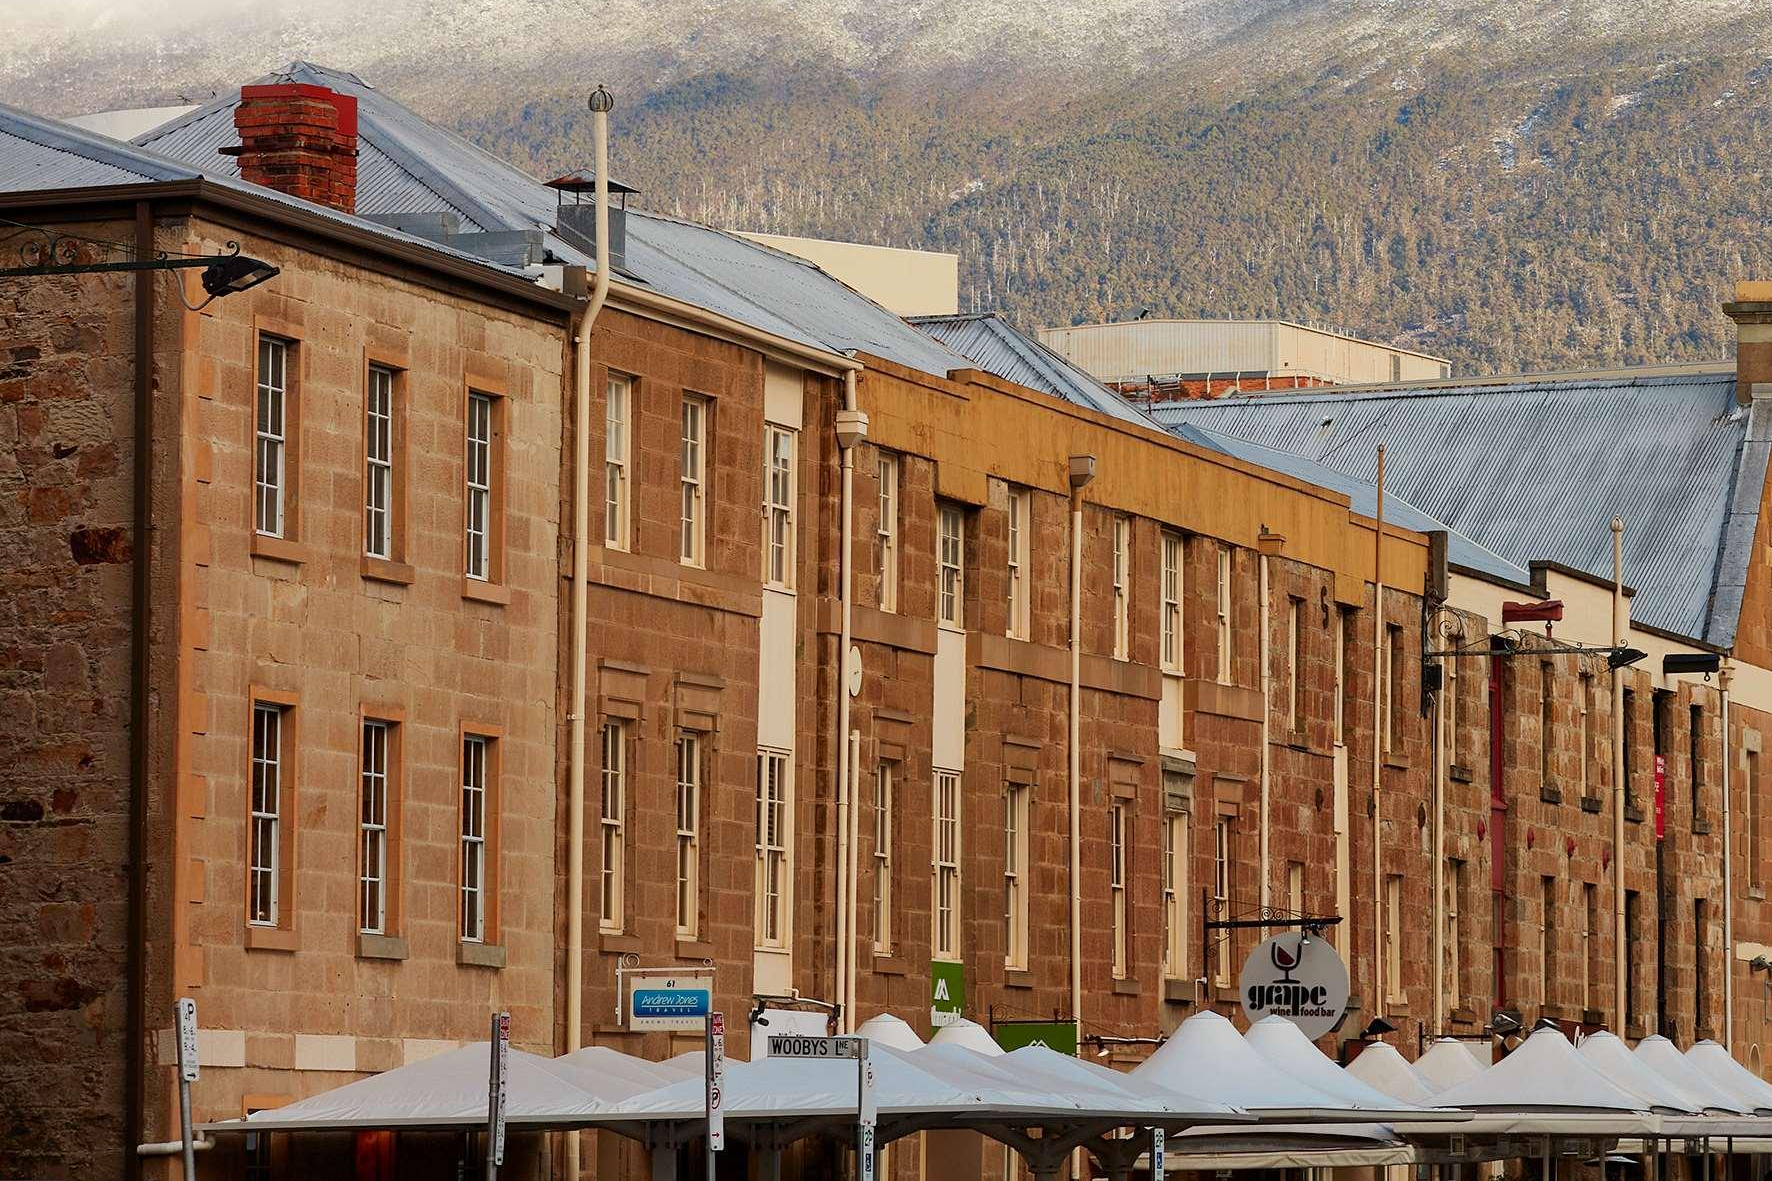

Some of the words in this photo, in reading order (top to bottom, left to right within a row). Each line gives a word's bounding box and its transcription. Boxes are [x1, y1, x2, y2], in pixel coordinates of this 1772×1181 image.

[666, 979, 676, 988] 61
[641, 994, 675, 1005] Andrew
[675, 994, 699, 1005] Jones
[1248, 985, 1327, 1016] grape
[1270, 1006, 1291, 1017] wine
[1300, 1006, 1320, 1017] food
[1321, 1006, 1335, 1017] bar
[772, 1038, 828, 1056] WOOBYS
